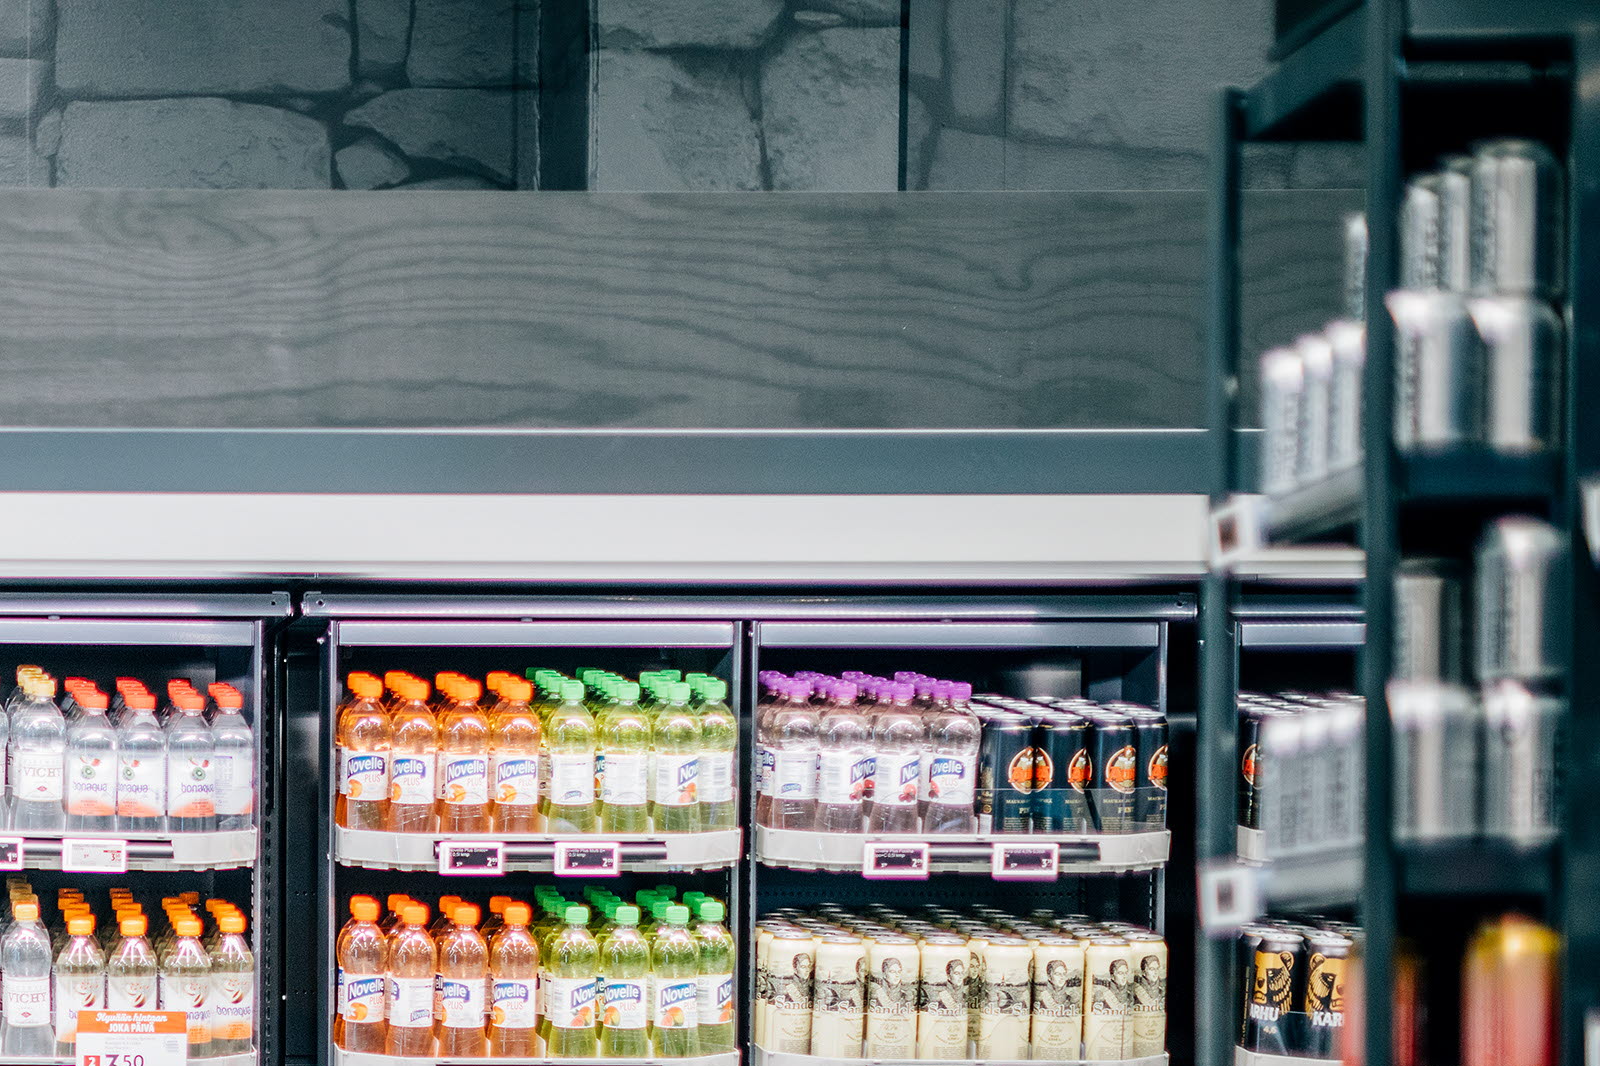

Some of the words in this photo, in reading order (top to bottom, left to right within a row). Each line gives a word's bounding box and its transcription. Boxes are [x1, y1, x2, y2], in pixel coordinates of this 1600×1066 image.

[449, 761, 484, 780] Novelle
[499, 761, 536, 780] Novelle
[364, 774, 381, 783] PLUS
[404, 777, 420, 786] PLUS
[349, 979, 384, 998] Novelle
[443, 983, 469, 998] velle
[8, 992, 46, 1003] VICHY
[448, 1001, 463, 1010] PLUS
[506, 1001, 523, 1010] PLUS
[620, 1001, 636, 1010] PLUS
[869, 1000, 915, 1015] Sandels
[1034, 1001, 1079, 1017] Sandels
[1250, 1003, 1279, 1022] ARHU
[1313, 1011, 1344, 1027] KAR
[108, 1023, 130, 1033] JOKA
[131, 1022, 155, 1033] PÄIVÄ
[88, 1057, 96, 1066] 2
